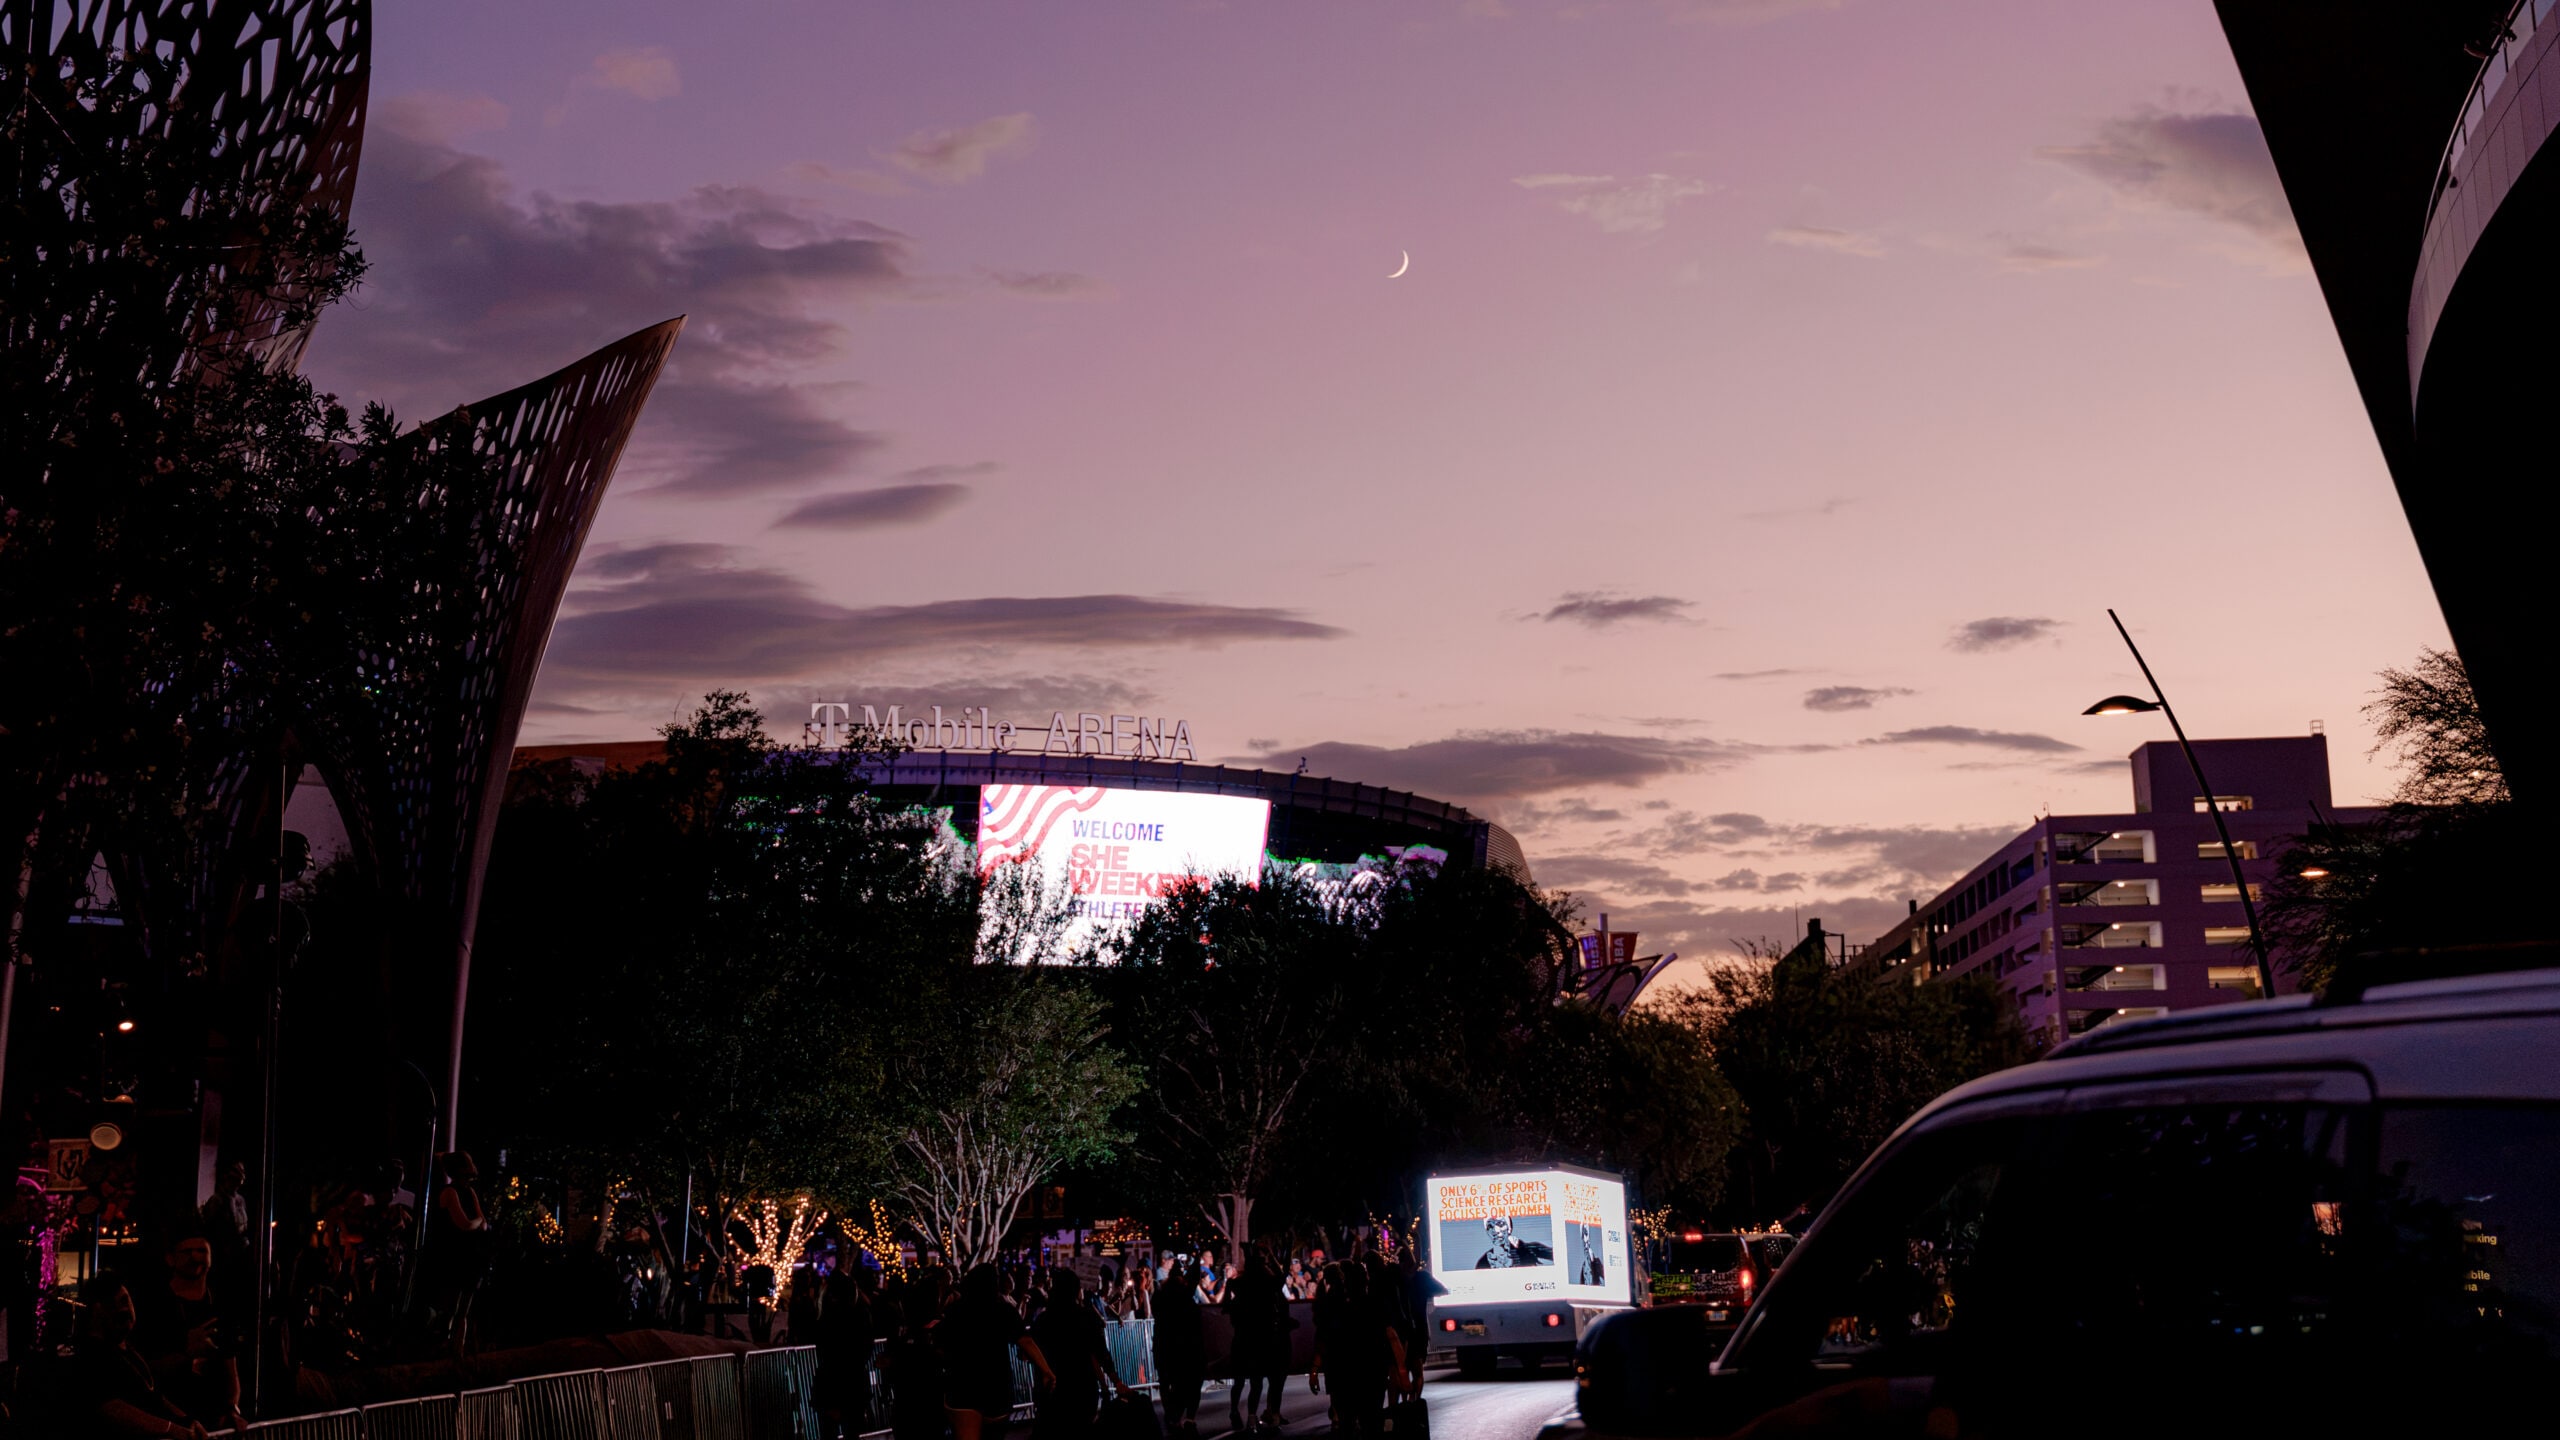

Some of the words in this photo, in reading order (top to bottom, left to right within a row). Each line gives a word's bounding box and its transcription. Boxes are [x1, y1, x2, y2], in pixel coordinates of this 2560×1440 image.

[1044, 711, 1198, 760] ARENA
[1073, 820, 1164, 841] WELCOME
[1071, 843, 1129, 870] SHE
[1440, 1185, 1467, 1197] ONLY
[1489, 1183, 1503, 1195] OF
[1505, 1180, 1548, 1194] SPORTS
[1441, 1195, 1486, 1209] SCIENCE
[1488, 1192, 1547, 1206] RESEARCH
[1439, 1207, 1488, 1222] FOCUSES
[1490, 1207, 1506, 1219] ON
[1508, 1204, 1552, 1218] WOMEN
